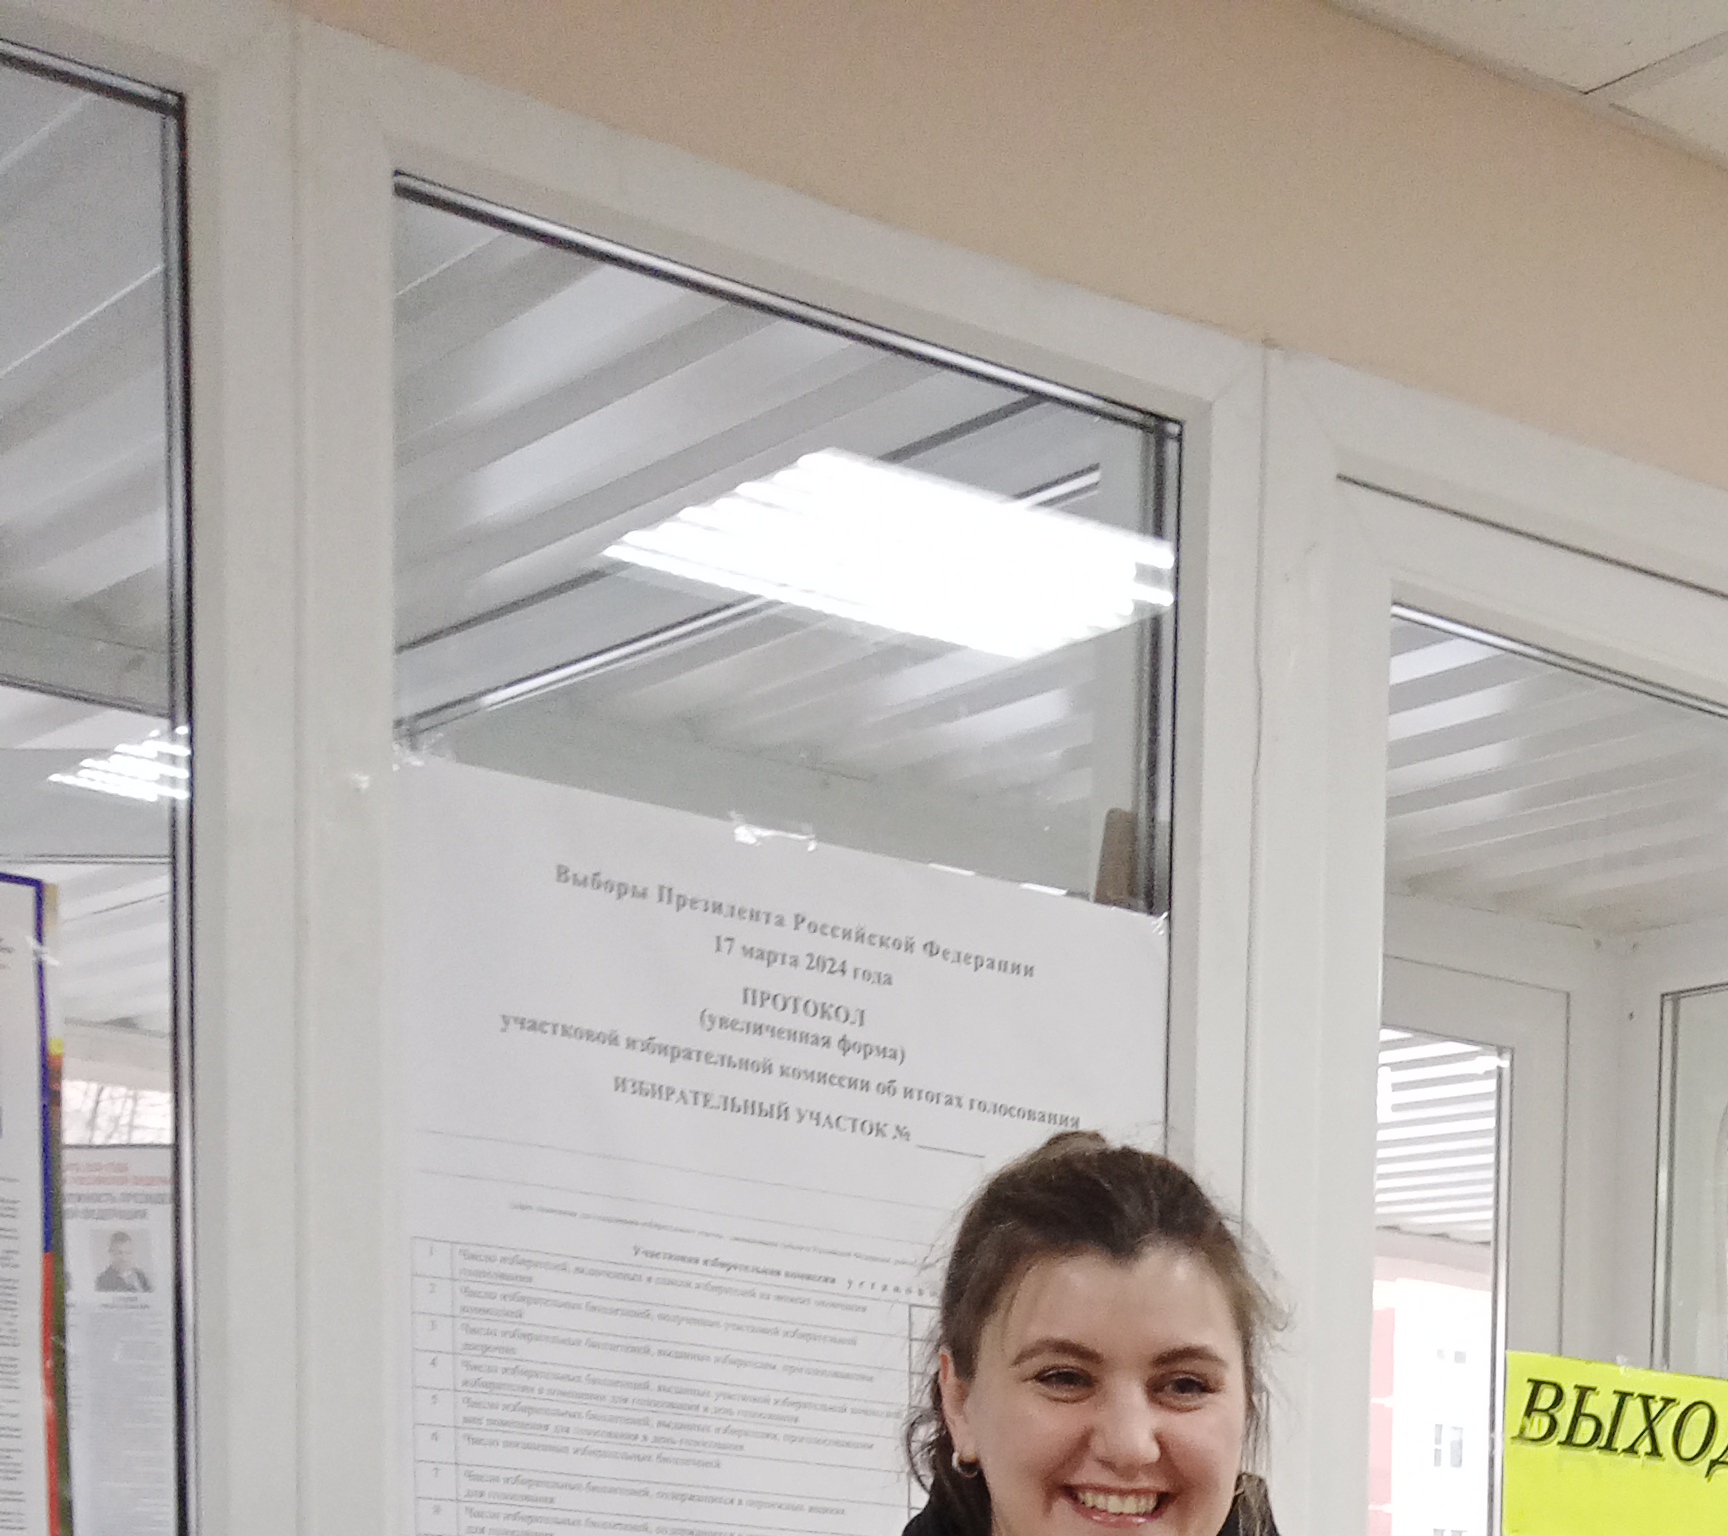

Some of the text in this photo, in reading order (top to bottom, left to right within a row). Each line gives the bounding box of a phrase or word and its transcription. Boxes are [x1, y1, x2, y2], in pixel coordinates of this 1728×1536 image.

[555, 864, 1035, 978] Выборы Президента Российской Федерации
[715, 935, 893, 987] 17 марта 2024 года
[699, 1008, 906, 1066] (увеличенная форма)
[742, 986, 865, 1028] ПРОТОКОЛ
[500, 1011, 1081, 1131] участковой избирательной комиссии об итогах голосования
[614, 1076, 790, 1122] ИЗБИРАТЕЛЬНЫЙ
[796, 1107, 889, 1140] УЧАСТОК
